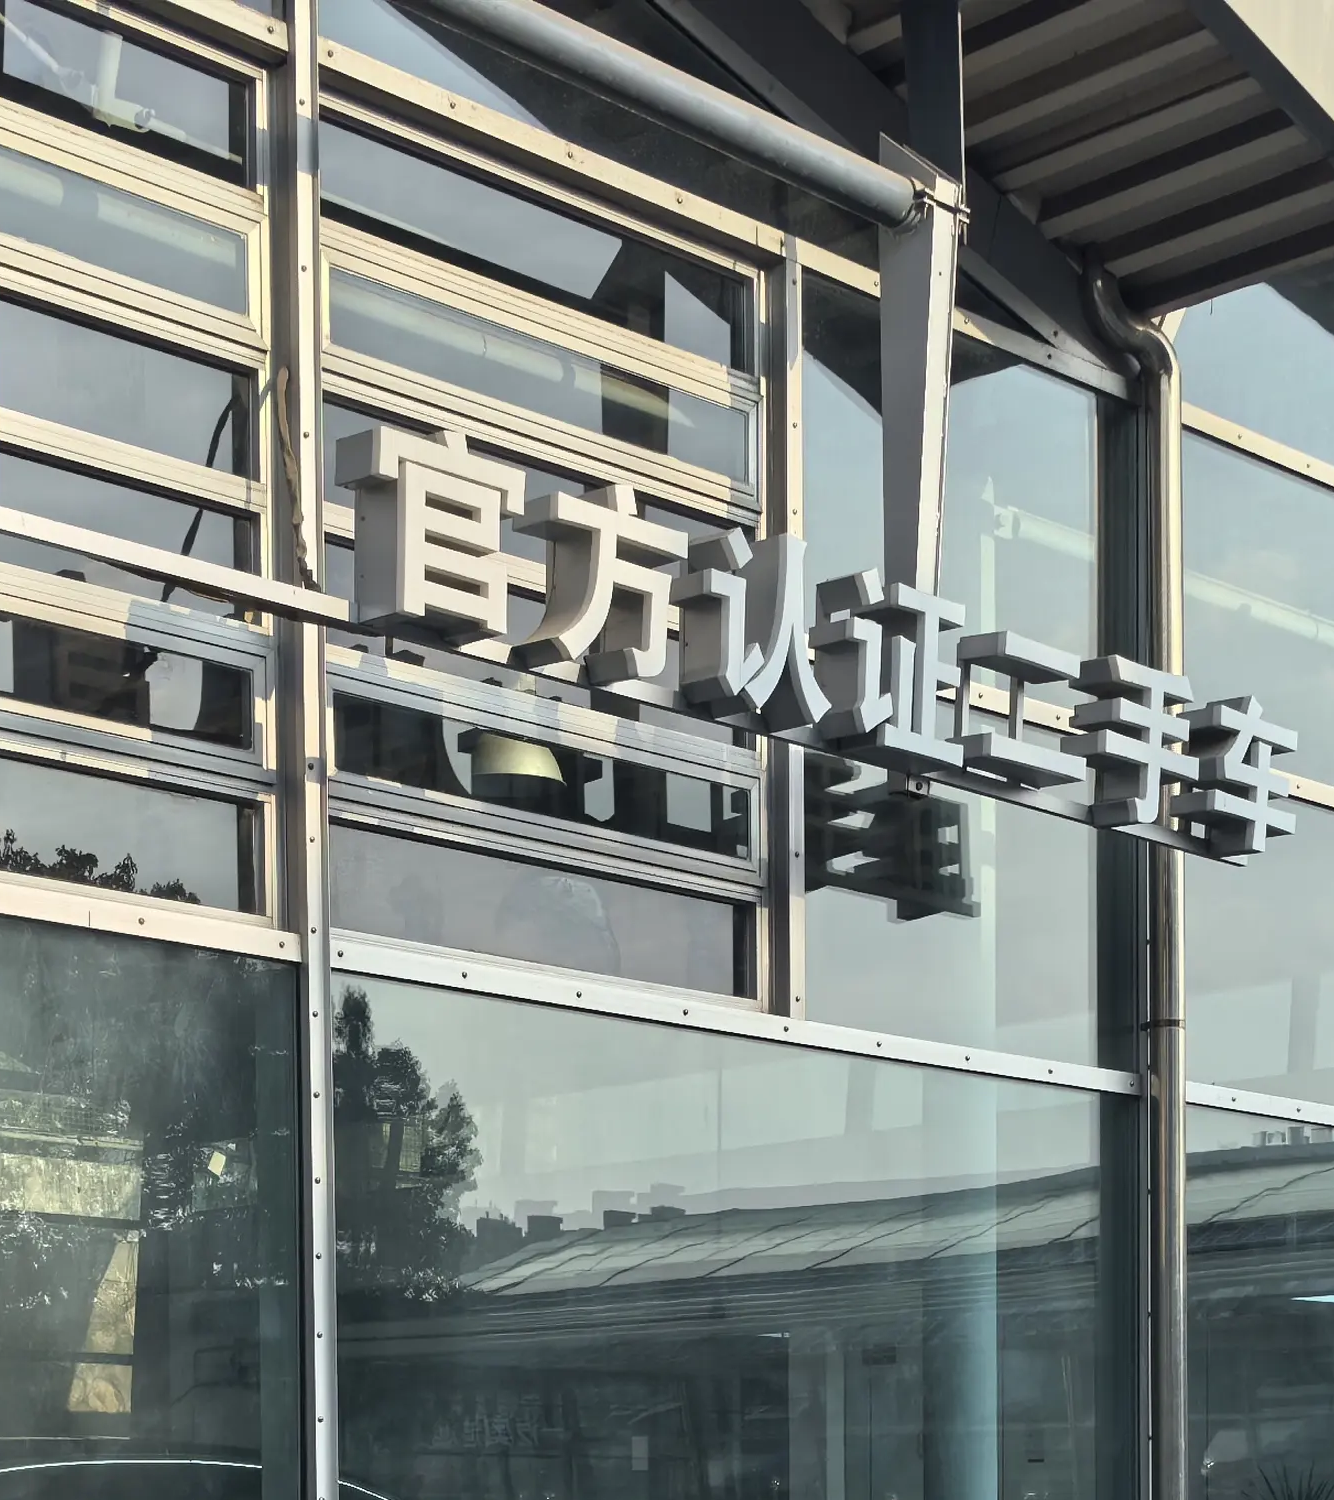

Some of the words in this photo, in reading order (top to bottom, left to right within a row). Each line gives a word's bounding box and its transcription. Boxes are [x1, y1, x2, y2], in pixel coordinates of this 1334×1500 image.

[335, 428, 1298, 856] 官方认证二手车
